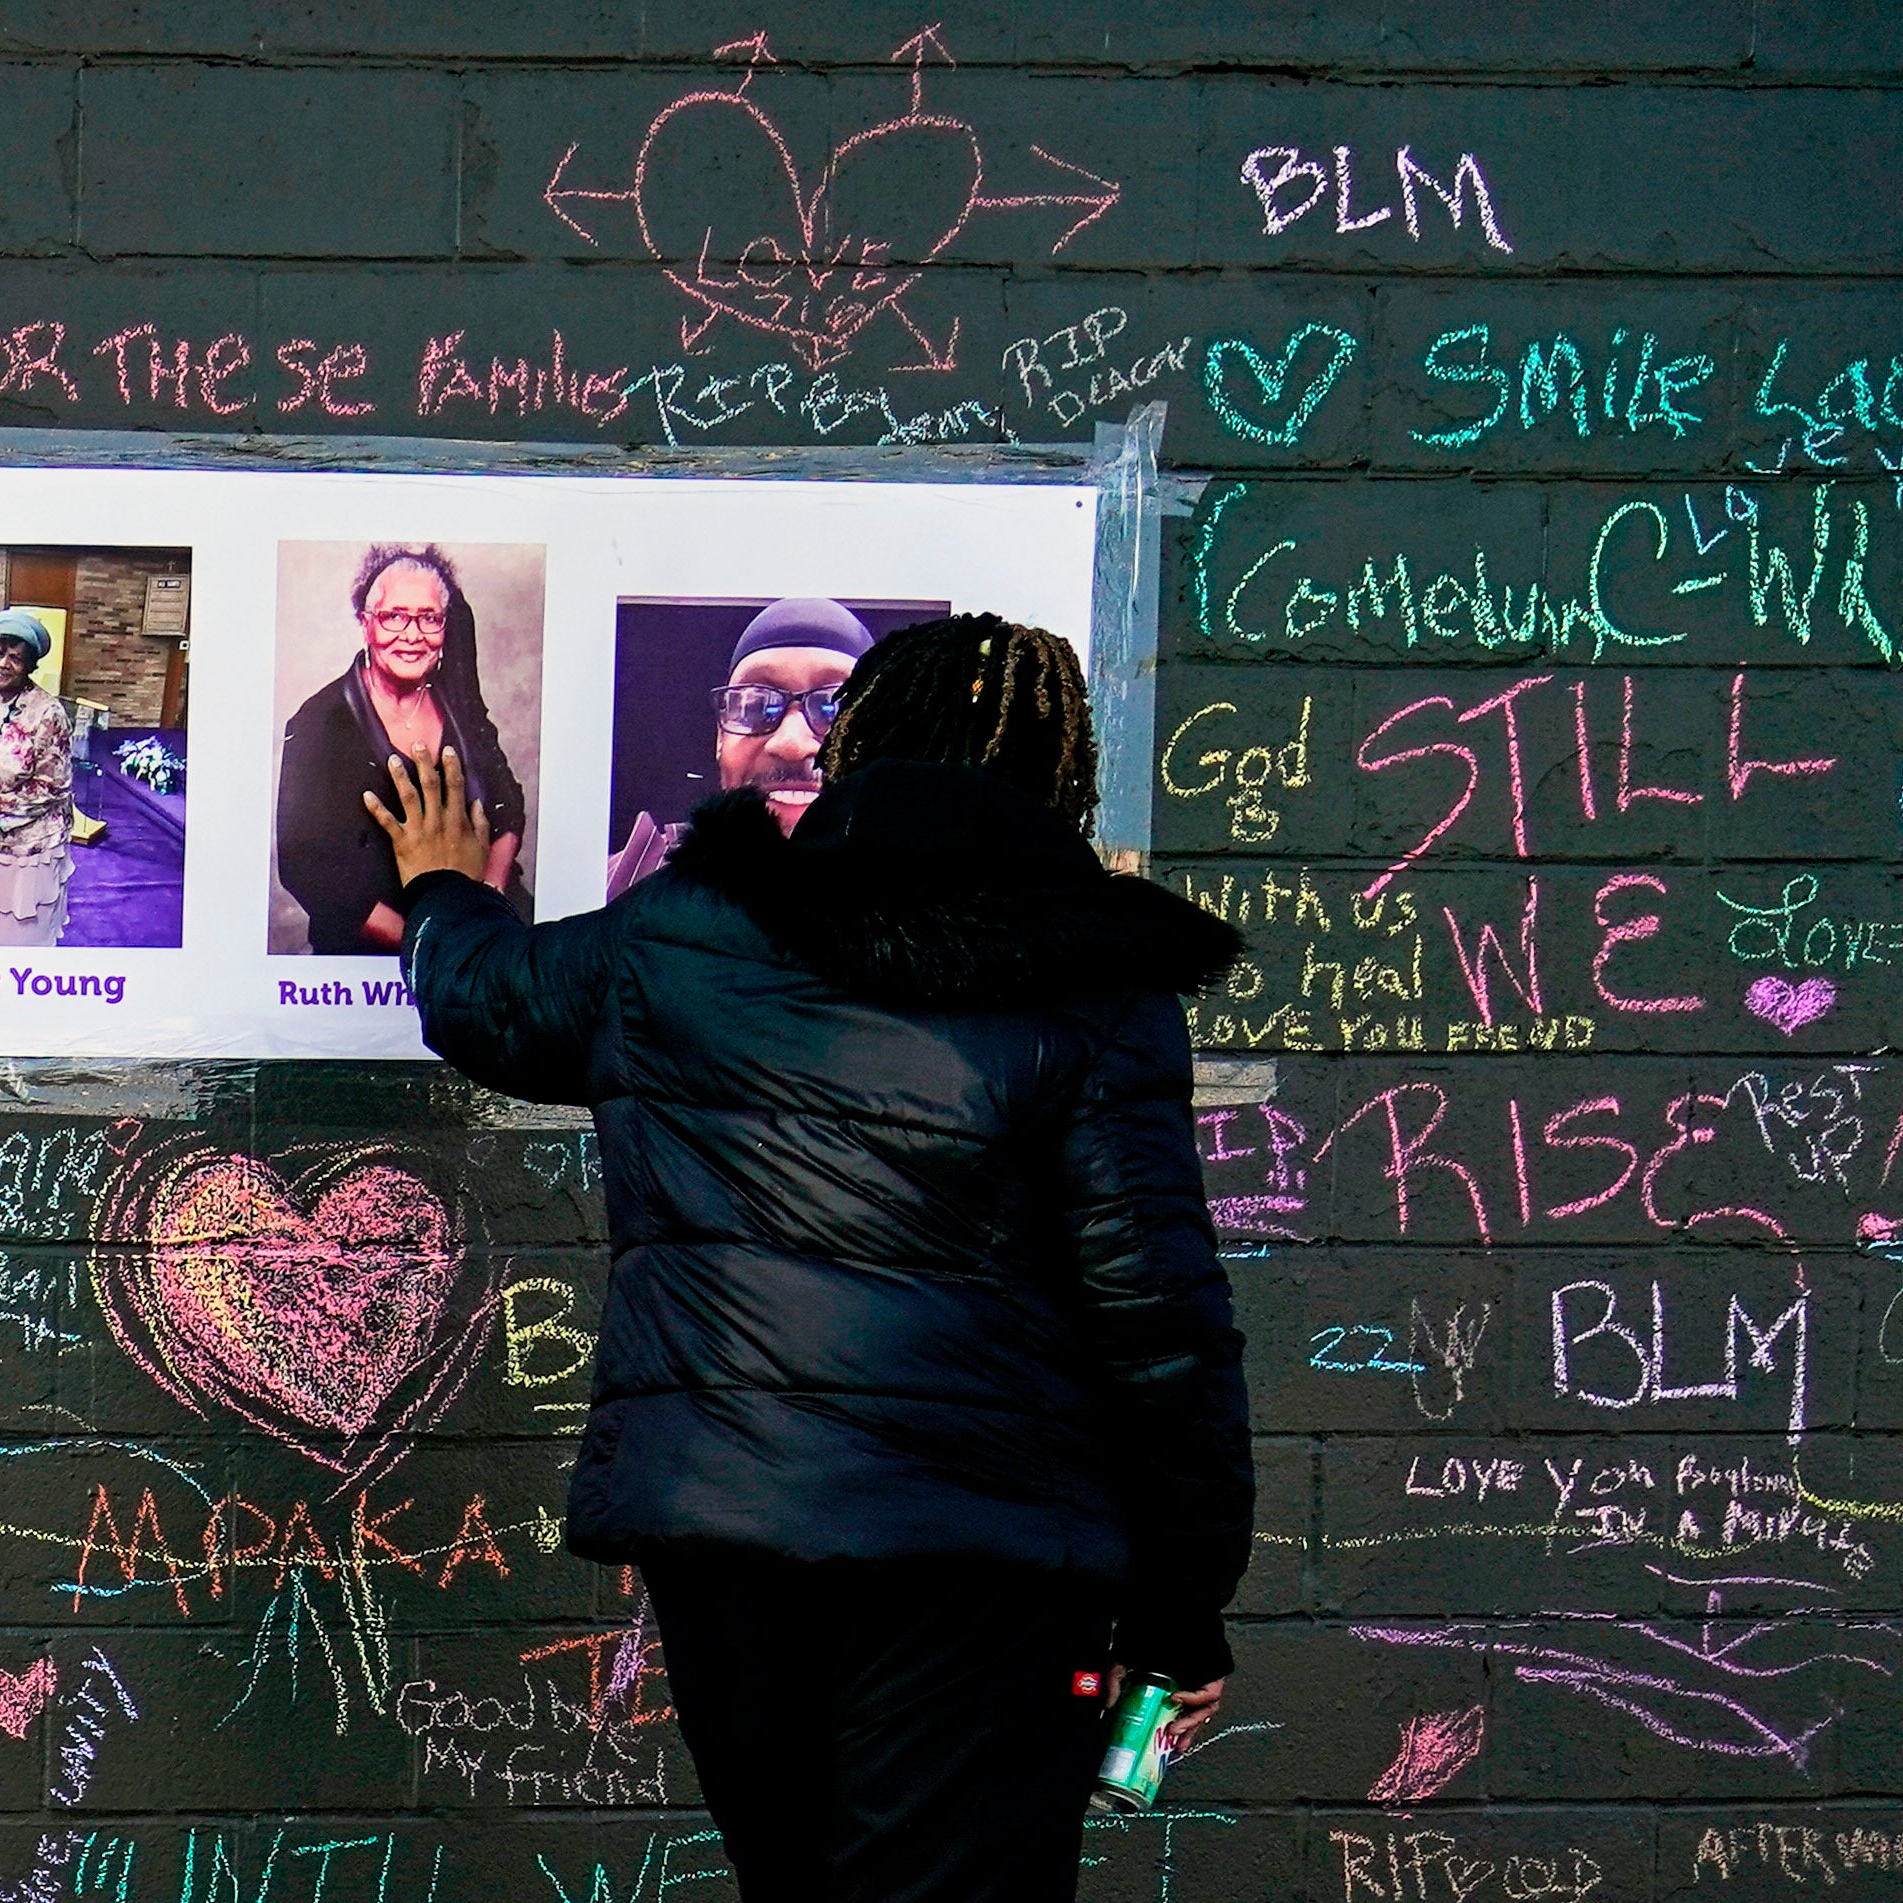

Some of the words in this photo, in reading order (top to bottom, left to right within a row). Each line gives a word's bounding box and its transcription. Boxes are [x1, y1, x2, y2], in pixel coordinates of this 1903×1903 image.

[1240, 145, 1514, 254] BLM
[1001, 305, 1130, 409] RIP
[1160, 696, 1312, 798] God
[1357, 660, 1838, 900] STILL
[1349, 892, 1418, 937] us
[10, 969, 128, 1005] Young
[278, 980, 353, 1006] Ruth
[1553, 1278, 1812, 1446] BLM
[1329, 1826, 1458, 1903] RIP
